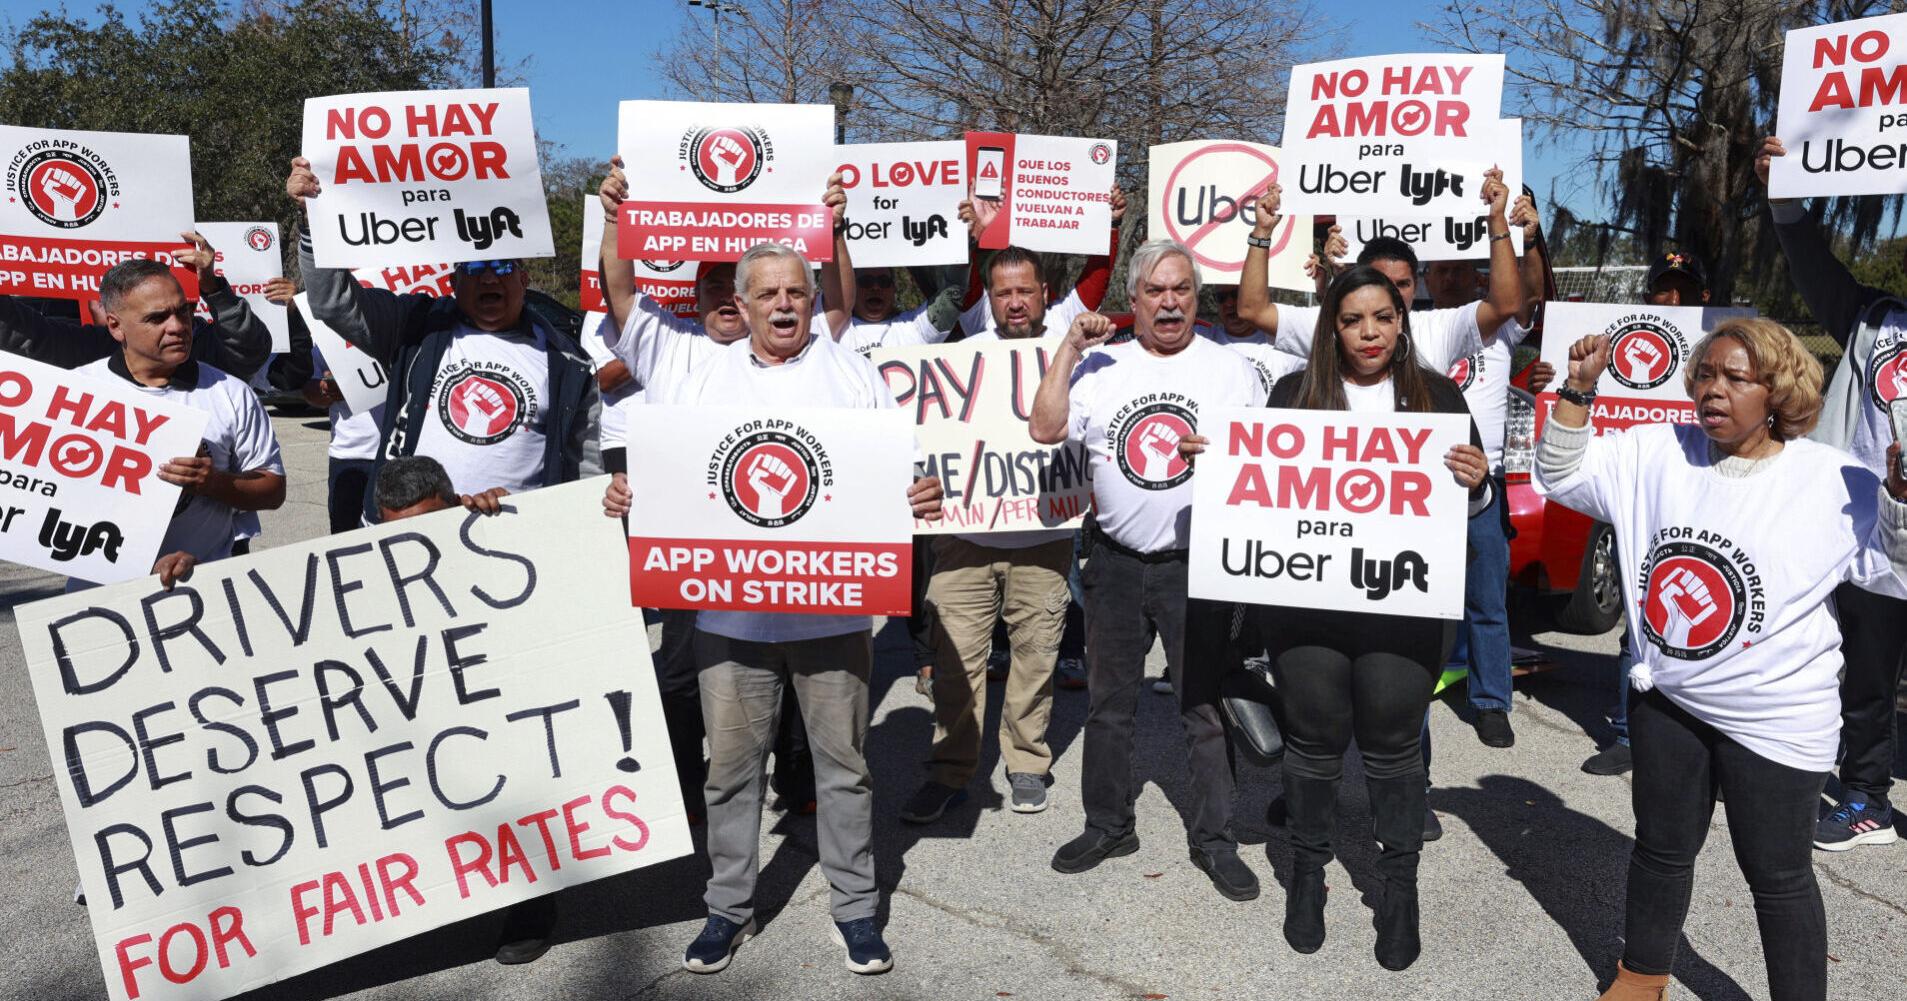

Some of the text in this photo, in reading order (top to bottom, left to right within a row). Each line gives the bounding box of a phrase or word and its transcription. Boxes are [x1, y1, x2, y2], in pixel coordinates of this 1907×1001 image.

[1812, 30, 1890, 69] NO
[1311, 65, 1473, 101] NO HAY
[326, 102, 499, 140] NO HAY
[1306, 99, 1471, 139] AMOR
[678, 123, 699, 160] JUSTIC
[1358, 142, 1404, 160] para
[7, 150, 28, 192] JUSTICE
[25, 139, 50, 154] FOR
[52, 139, 78, 150] APP
[81, 146, 120, 197] WORKERS
[334, 141, 511, 185] AMOR
[872, 160, 959, 188] LOVE
[1017, 174, 1069, 186] BUENOS
[1018, 159, 1071, 171] QUE LOS
[401, 187, 451, 206] para
[873, 196, 899, 210] for
[1016, 188, 1110, 203] CONDUCTORES
[1299, 163, 1464, 206] Uber lyft
[626, 209, 825, 229] TRABAJADORES DE
[1015, 203, 1085, 216] VUELVAN A
[1015, 217, 1079, 230] TRABAJAR
[1177, 184, 1257, 227] Ube
[338, 206, 524, 250] Uber lyft
[643, 235, 686, 252] APP
[692, 236, 721, 253] EN
[844, 213, 948, 246] ber lyft
[1356, 216, 1489, 251] Uber lyf
[0, 244, 147, 267] BAJADORES
[32, 272, 65, 290] EN
[1617, 313, 1690, 363] FOR APP WORKERS
[430, 364, 460, 399] JUSTICE
[485, 361, 511, 373] APP
[878, 346, 1050, 425] PAY U
[45, 385, 171, 446] HAY
[1107, 392, 1185, 450] JUSTICE FOR APP
[707, 418, 834, 487] JUSTICE FOR APP WORKERS
[1228, 421, 1433, 464] NO HAY
[1225, 463, 1432, 517] AMOR
[38, 507, 124, 564] lyft
[1297, 519, 1354, 539] para
[643, 547, 898, 577] APP WORKERS
[1221, 537, 1429, 601] Uber lyft
[1638, 526, 1765, 634] JUSTICE FOR APP WORKERS
[47, 504, 537, 695] DRIVERS
[680, 578, 863, 607] ON STRIKE
[63, 622, 501, 809] DESERVE
[114, 784, 650, 1000] FOR FAIR RATES
